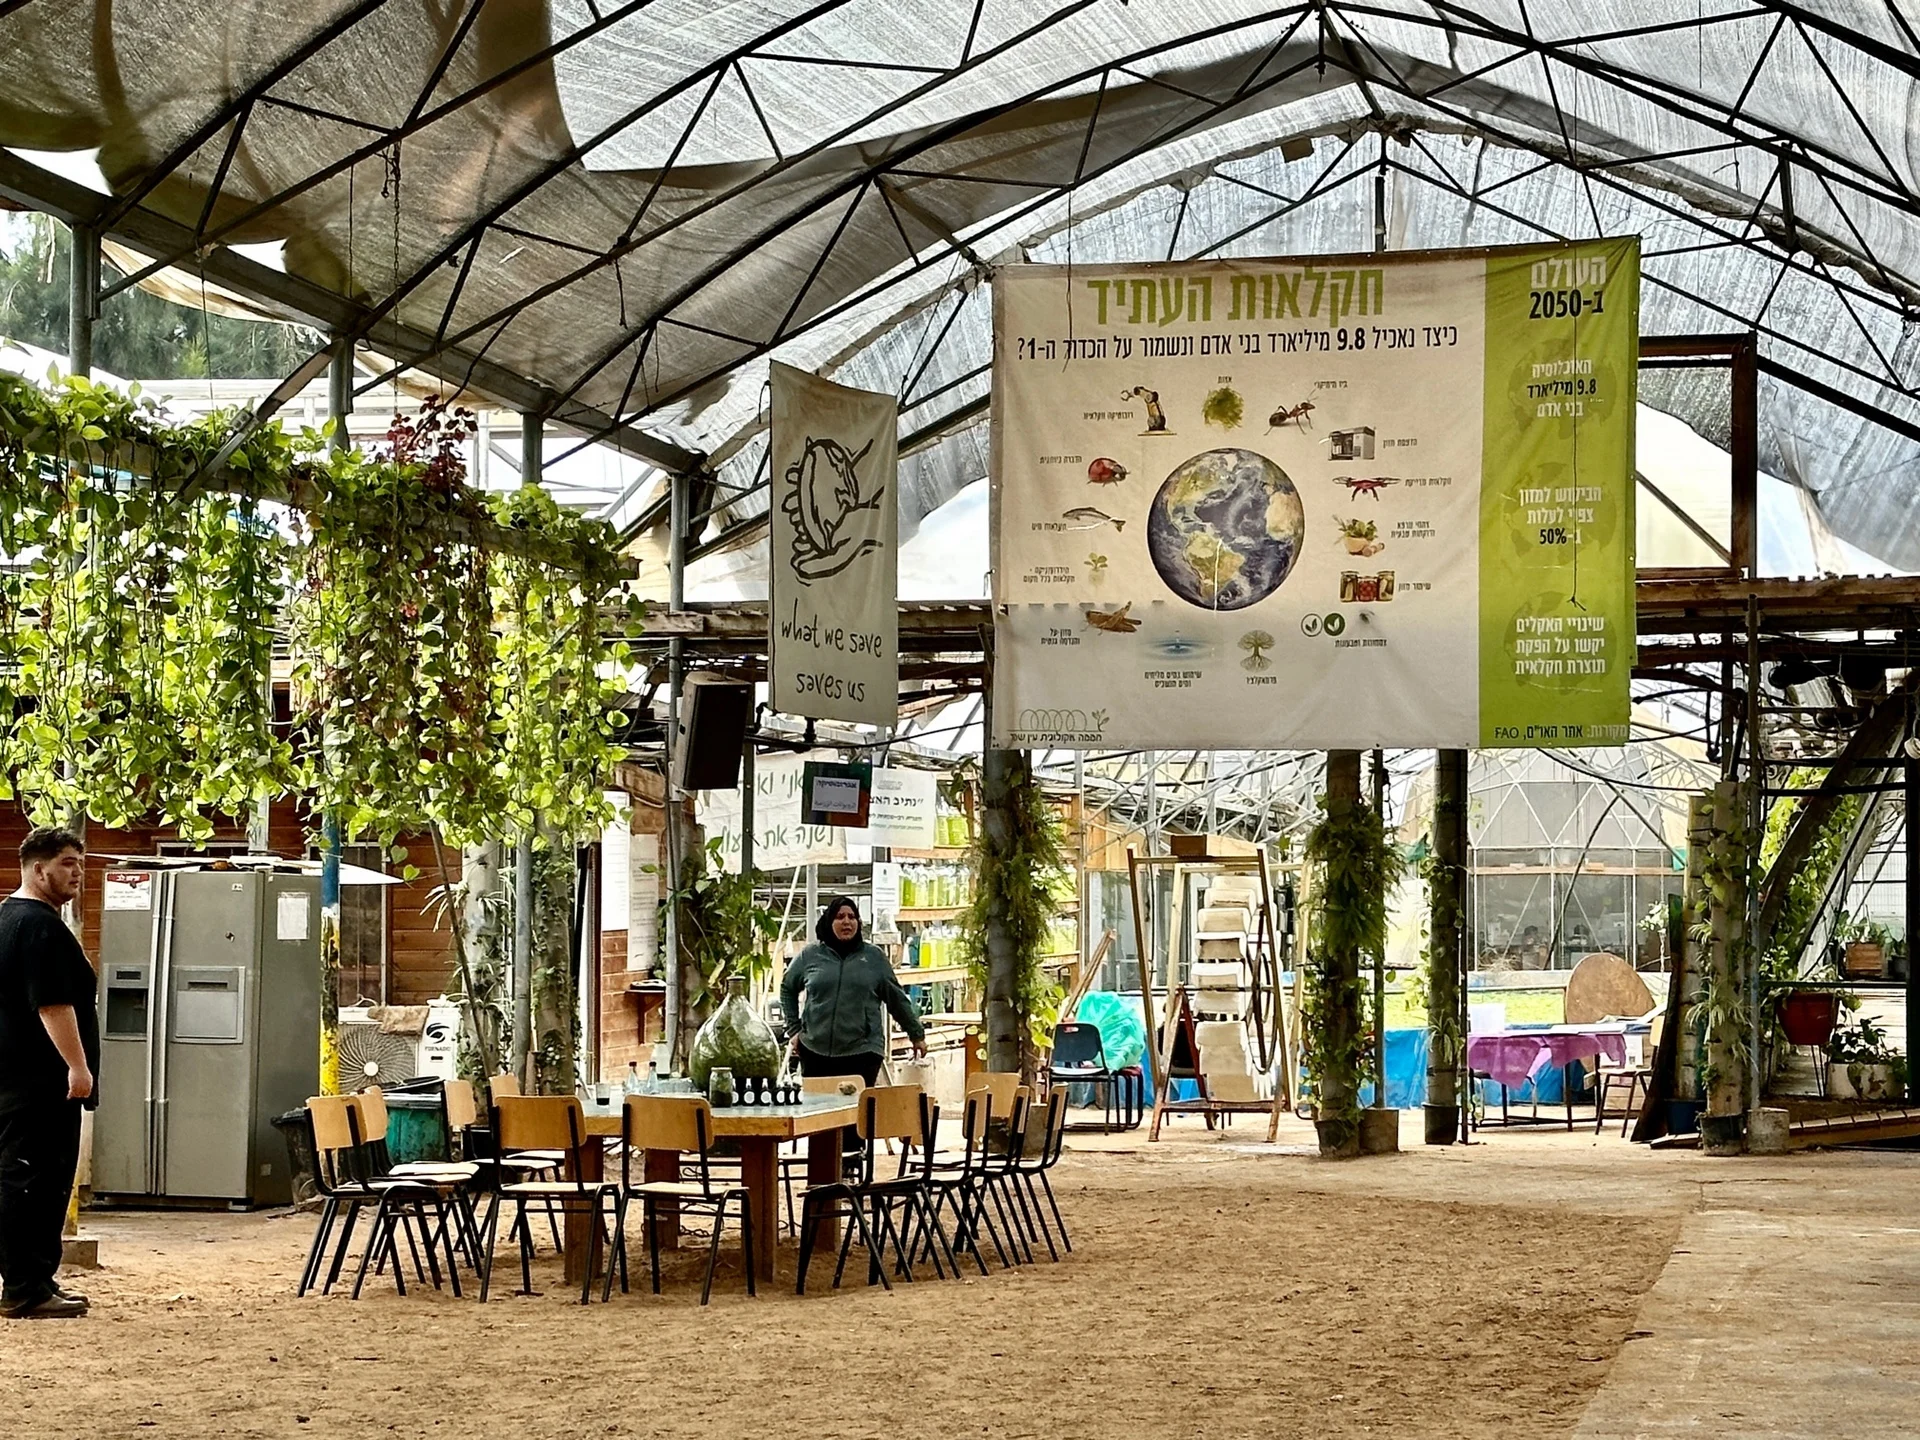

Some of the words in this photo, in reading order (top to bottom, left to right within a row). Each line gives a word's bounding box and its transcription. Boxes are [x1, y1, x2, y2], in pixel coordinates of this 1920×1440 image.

[1531, 256, 1607, 289] העולם
[1087, 277, 1213, 328] העתיד
[1227, 265, 1384, 328] חקלאות
[1529, 289, 1604, 319] ב-2050
[1114, 335, 1132, 359] על
[1139, 336, 1194, 357] ונשמור
[1200, 334, 1231, 355] אדם
[1239, 333, 1260, 354] בני
[1267, 329, 1331, 354] מיליארד
[1337, 327, 1366, 351] 9.8
[1372, 326, 1415, 350] נאכיל
[1422, 326, 1458, 347] כיצד
[1062, 338, 1107, 360] הכדור
[1532, 359, 1592, 378] האוכלוסיה
[1526, 380, 1573, 399] מיליארד
[1577, 378, 1597, 395] 9.8
[1537, 402, 1562, 418] אדם
[1564, 402, 1584, 417] בני
[1519, 486, 1551, 507] למזון
[1555, 486, 1602, 506] הביקוש
[1526, 506, 1564, 525] לעלות
[781, 598, 821, 649] what
[824, 628, 845, 652] we
[849, 633, 883, 658] save
[1516, 615, 1563, 636] האקלים
[1566, 616, 1604, 632] שינויי
[1516, 638, 1551, 657] הפקת
[1553, 636, 1570, 654] על
[1574, 637, 1605, 656] יקשו
[1515, 657, 1563, 678] חקלאית
[1566, 658, 1606, 675] תוצרת
[796, 672, 844, 699] saves
[847, 681, 866, 702] us
[1027, 734, 1038, 744] עין
[1040, 731, 1076, 744] אקולוגית
[1078, 733, 1103, 742] חממה
[1494, 727, 1520, 739] FAO
[1561, 725, 1584, 738] אתר
[763, 824, 788, 850] את
[795, 825, 834, 849] נשנה
